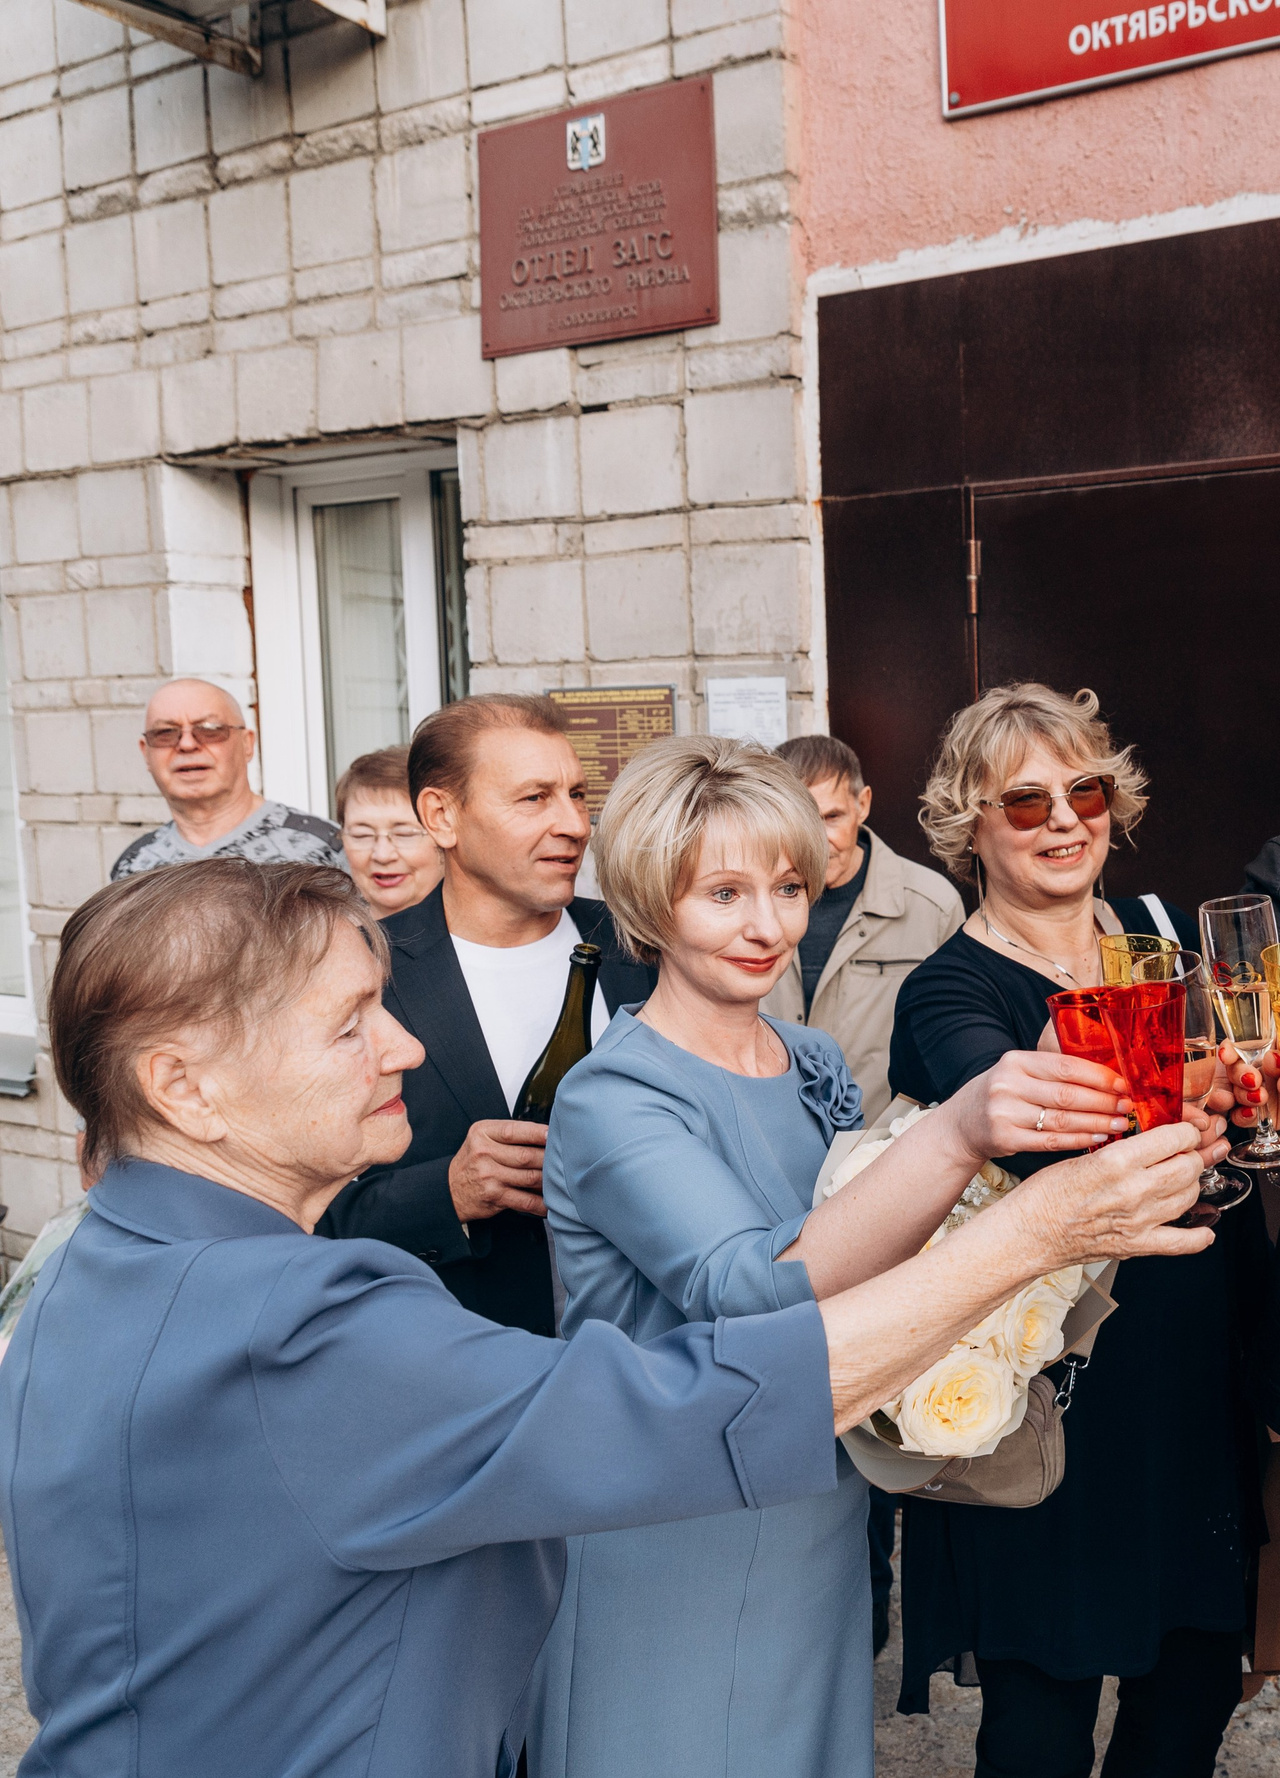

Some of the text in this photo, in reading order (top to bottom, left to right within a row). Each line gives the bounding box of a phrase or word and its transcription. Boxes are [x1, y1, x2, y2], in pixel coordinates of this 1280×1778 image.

[511, 230, 673, 286] ОТДЕЛ ЗАГС
[626, 264, 690, 291] РАЙОНА
